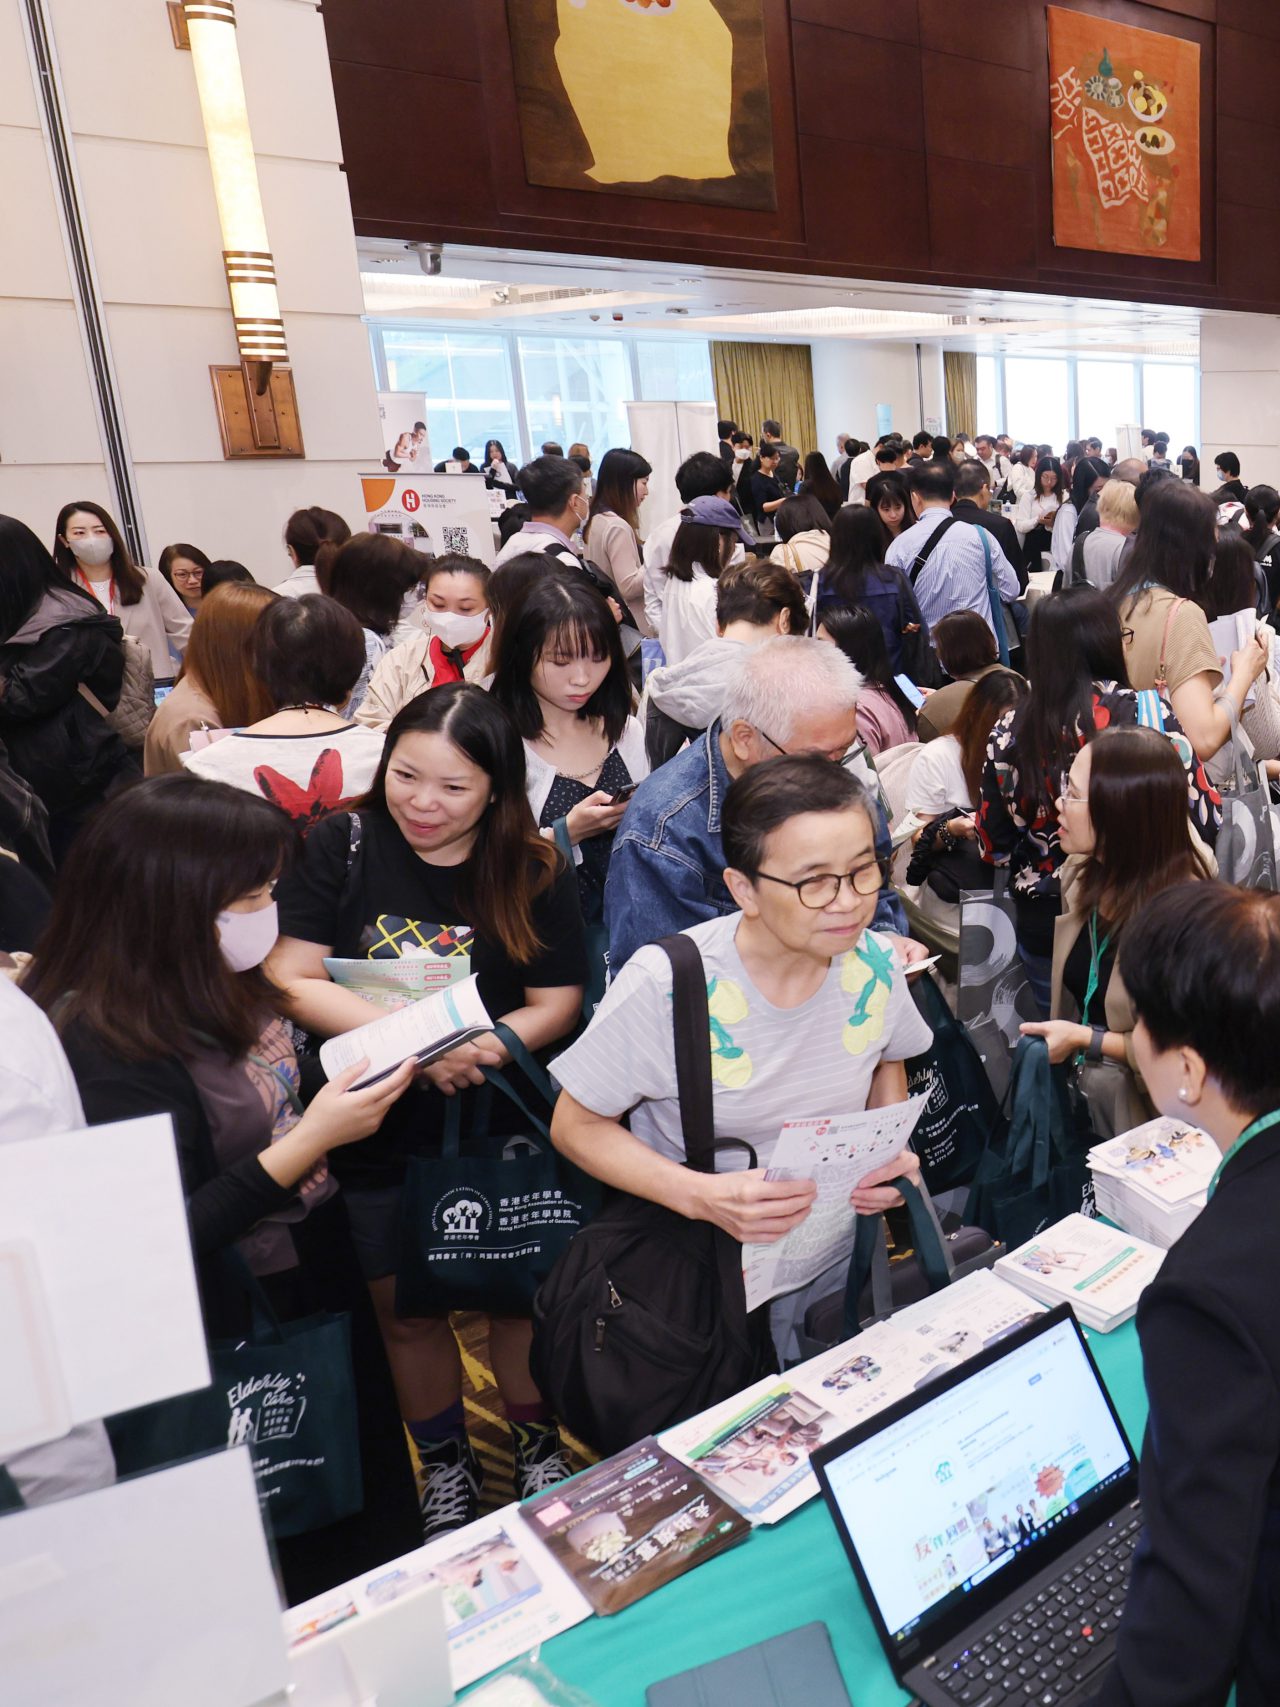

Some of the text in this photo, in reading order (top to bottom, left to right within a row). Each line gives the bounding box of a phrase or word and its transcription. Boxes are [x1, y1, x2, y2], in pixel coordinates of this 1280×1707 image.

[500, 1190, 562, 1207] 香港老年學會
[499, 1209, 572, 1226] 香港老年學學院
[227, 1372, 292, 1408] Elderly
[262, 1391, 295, 1407] Care
